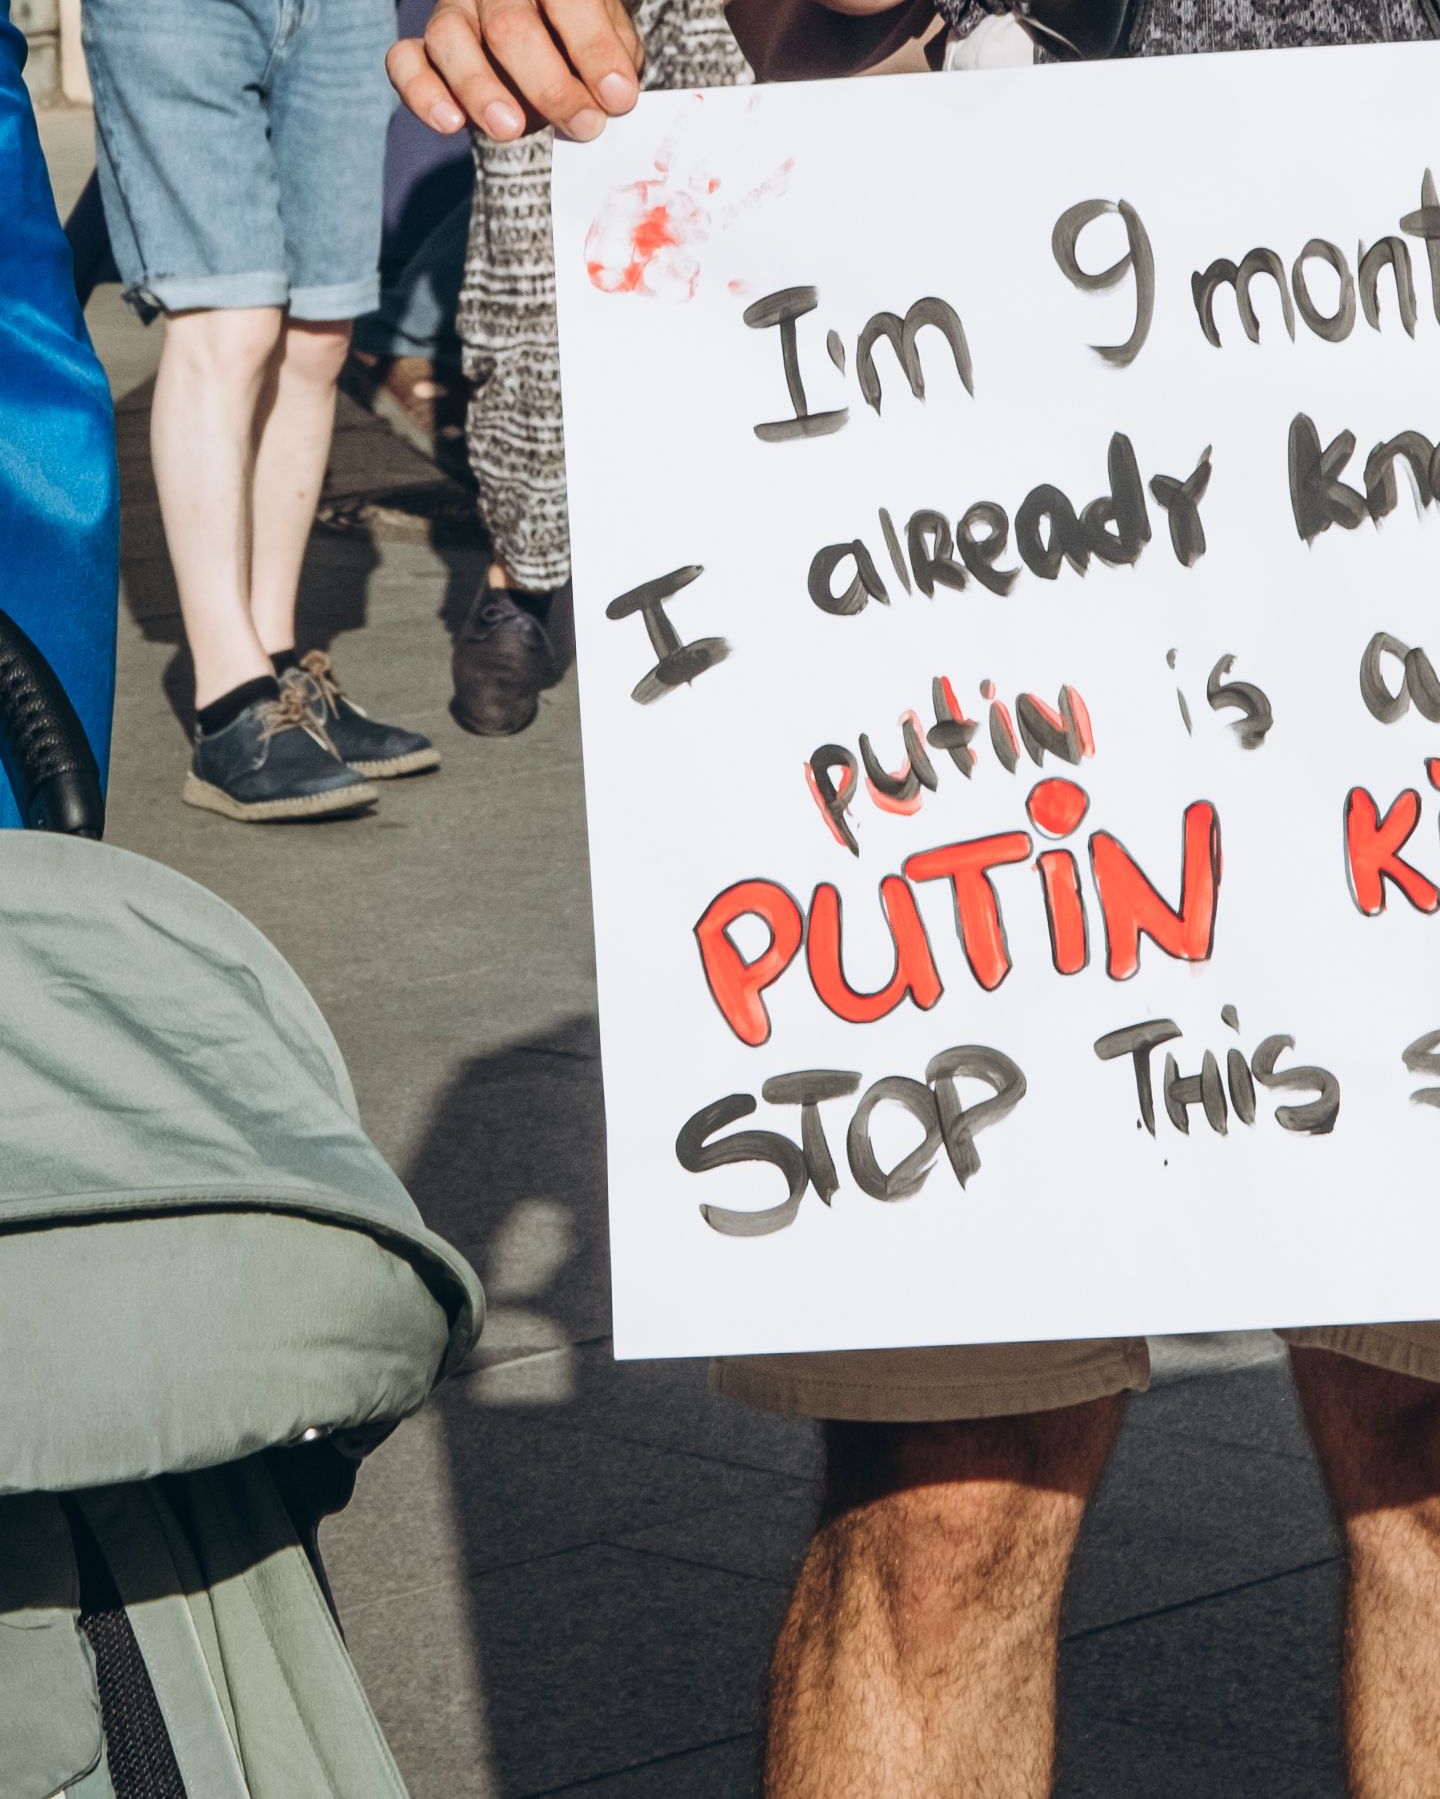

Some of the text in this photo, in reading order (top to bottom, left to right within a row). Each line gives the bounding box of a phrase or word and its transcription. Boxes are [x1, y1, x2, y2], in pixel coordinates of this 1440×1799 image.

[743, 284, 974, 442] I'm
[1050, 198, 1156, 368] 9
[605, 564, 732, 705] I
[1166, 648, 1274, 750] is
[675, 1045, 1027, 1237] STOP
